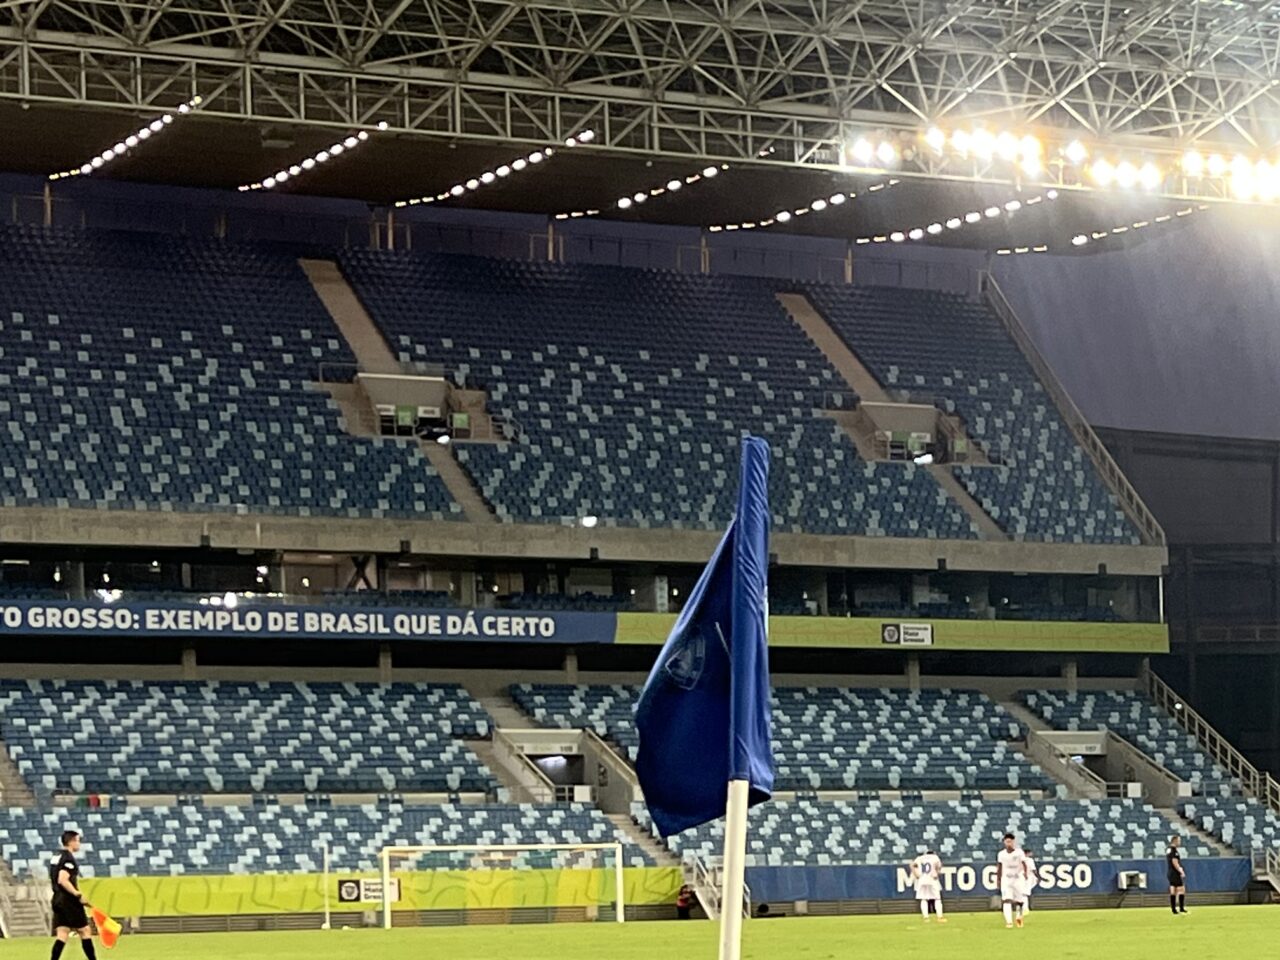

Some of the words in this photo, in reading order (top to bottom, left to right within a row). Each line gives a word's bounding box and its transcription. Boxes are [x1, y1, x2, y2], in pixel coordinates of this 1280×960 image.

[28, 607, 139, 630] GROSSO:
[145, 609, 262, 632] EXEMPLO
[267, 612, 299, 633] DE
[304, 612, 390, 634] BRASIL
[394, 614, 441, 636] QUE
[446, 611, 478, 635] DÁ
[482, 615, 555, 637] CERTO
[982, 863, 1092, 889] GSSO
